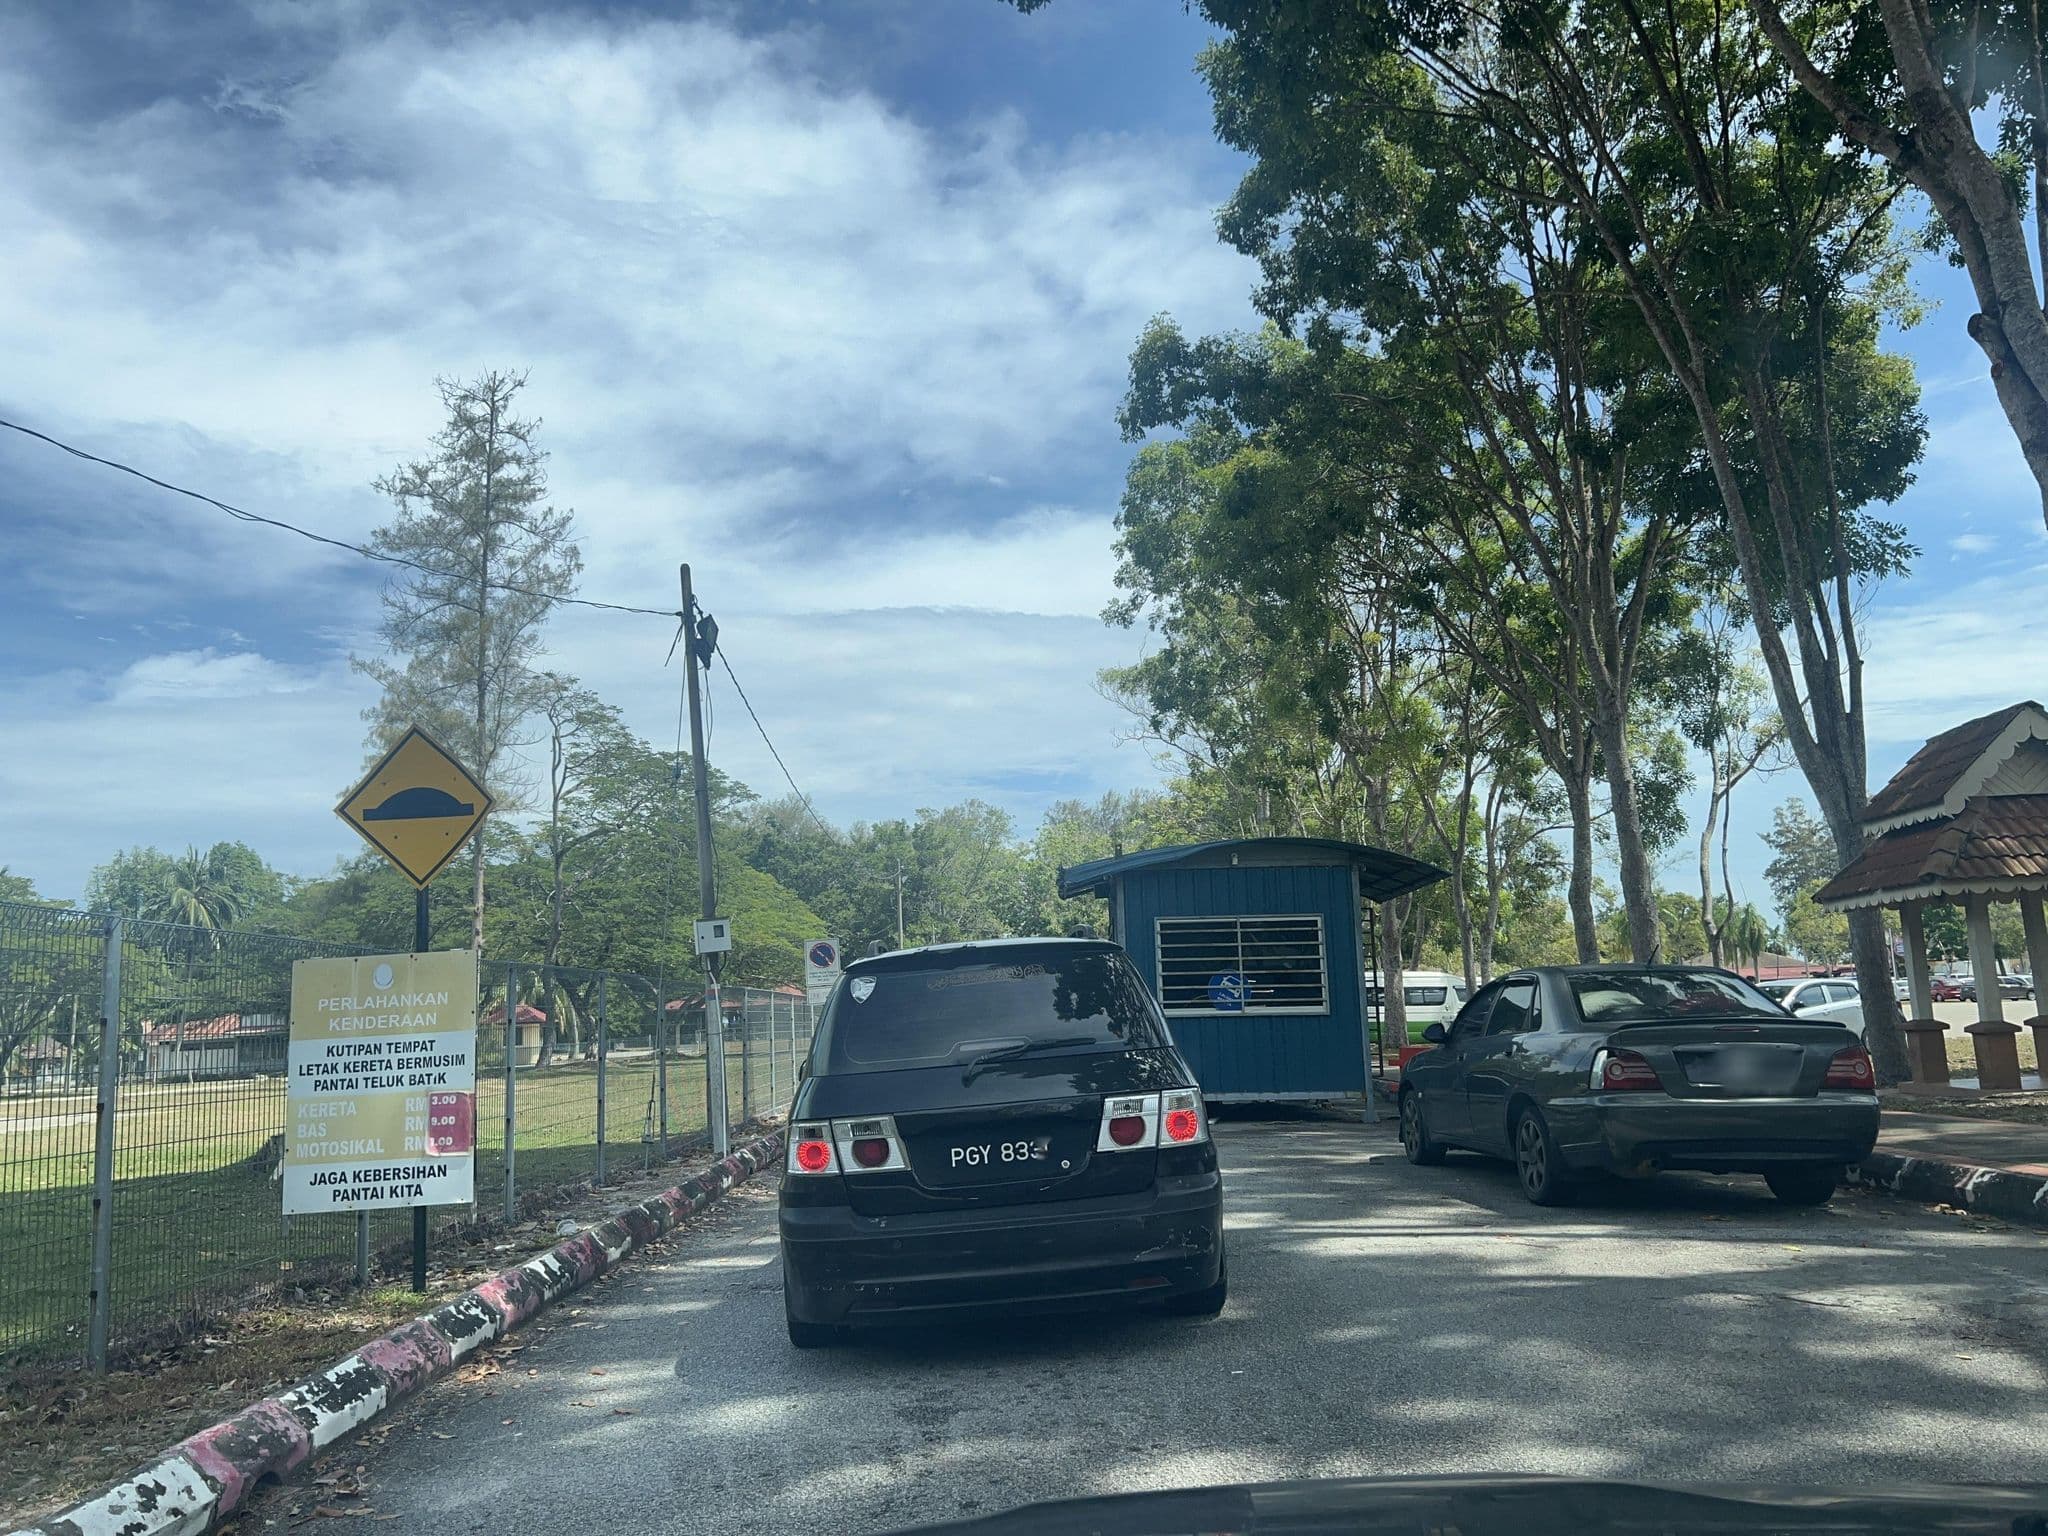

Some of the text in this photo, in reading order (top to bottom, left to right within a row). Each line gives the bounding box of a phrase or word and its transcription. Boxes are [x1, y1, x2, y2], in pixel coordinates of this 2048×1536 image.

[318, 992, 449, 1012] PERLAHANKAN
[329, 1013, 437, 1031] KENDERAAN
[326, 1039, 436, 1058] KUTIPAN TEMPAT
[299, 1053, 466, 1076] LETAK KERETA BERMUSIM
[314, 1072, 447, 1092] PANTAI TELUK BATIK
[297, 1101, 357, 1118] KERETA
[431, 1095, 457, 1105] 3.00
[297, 1122, 328, 1138] BAS
[296, 1138, 385, 1158] MOTOSIKAL
[951, 1144, 991, 1167] PGY
[309, 1164, 447, 1186] JAGA KEBERSIHAN
[332, 1183, 423, 1202] PANTAI KITA
